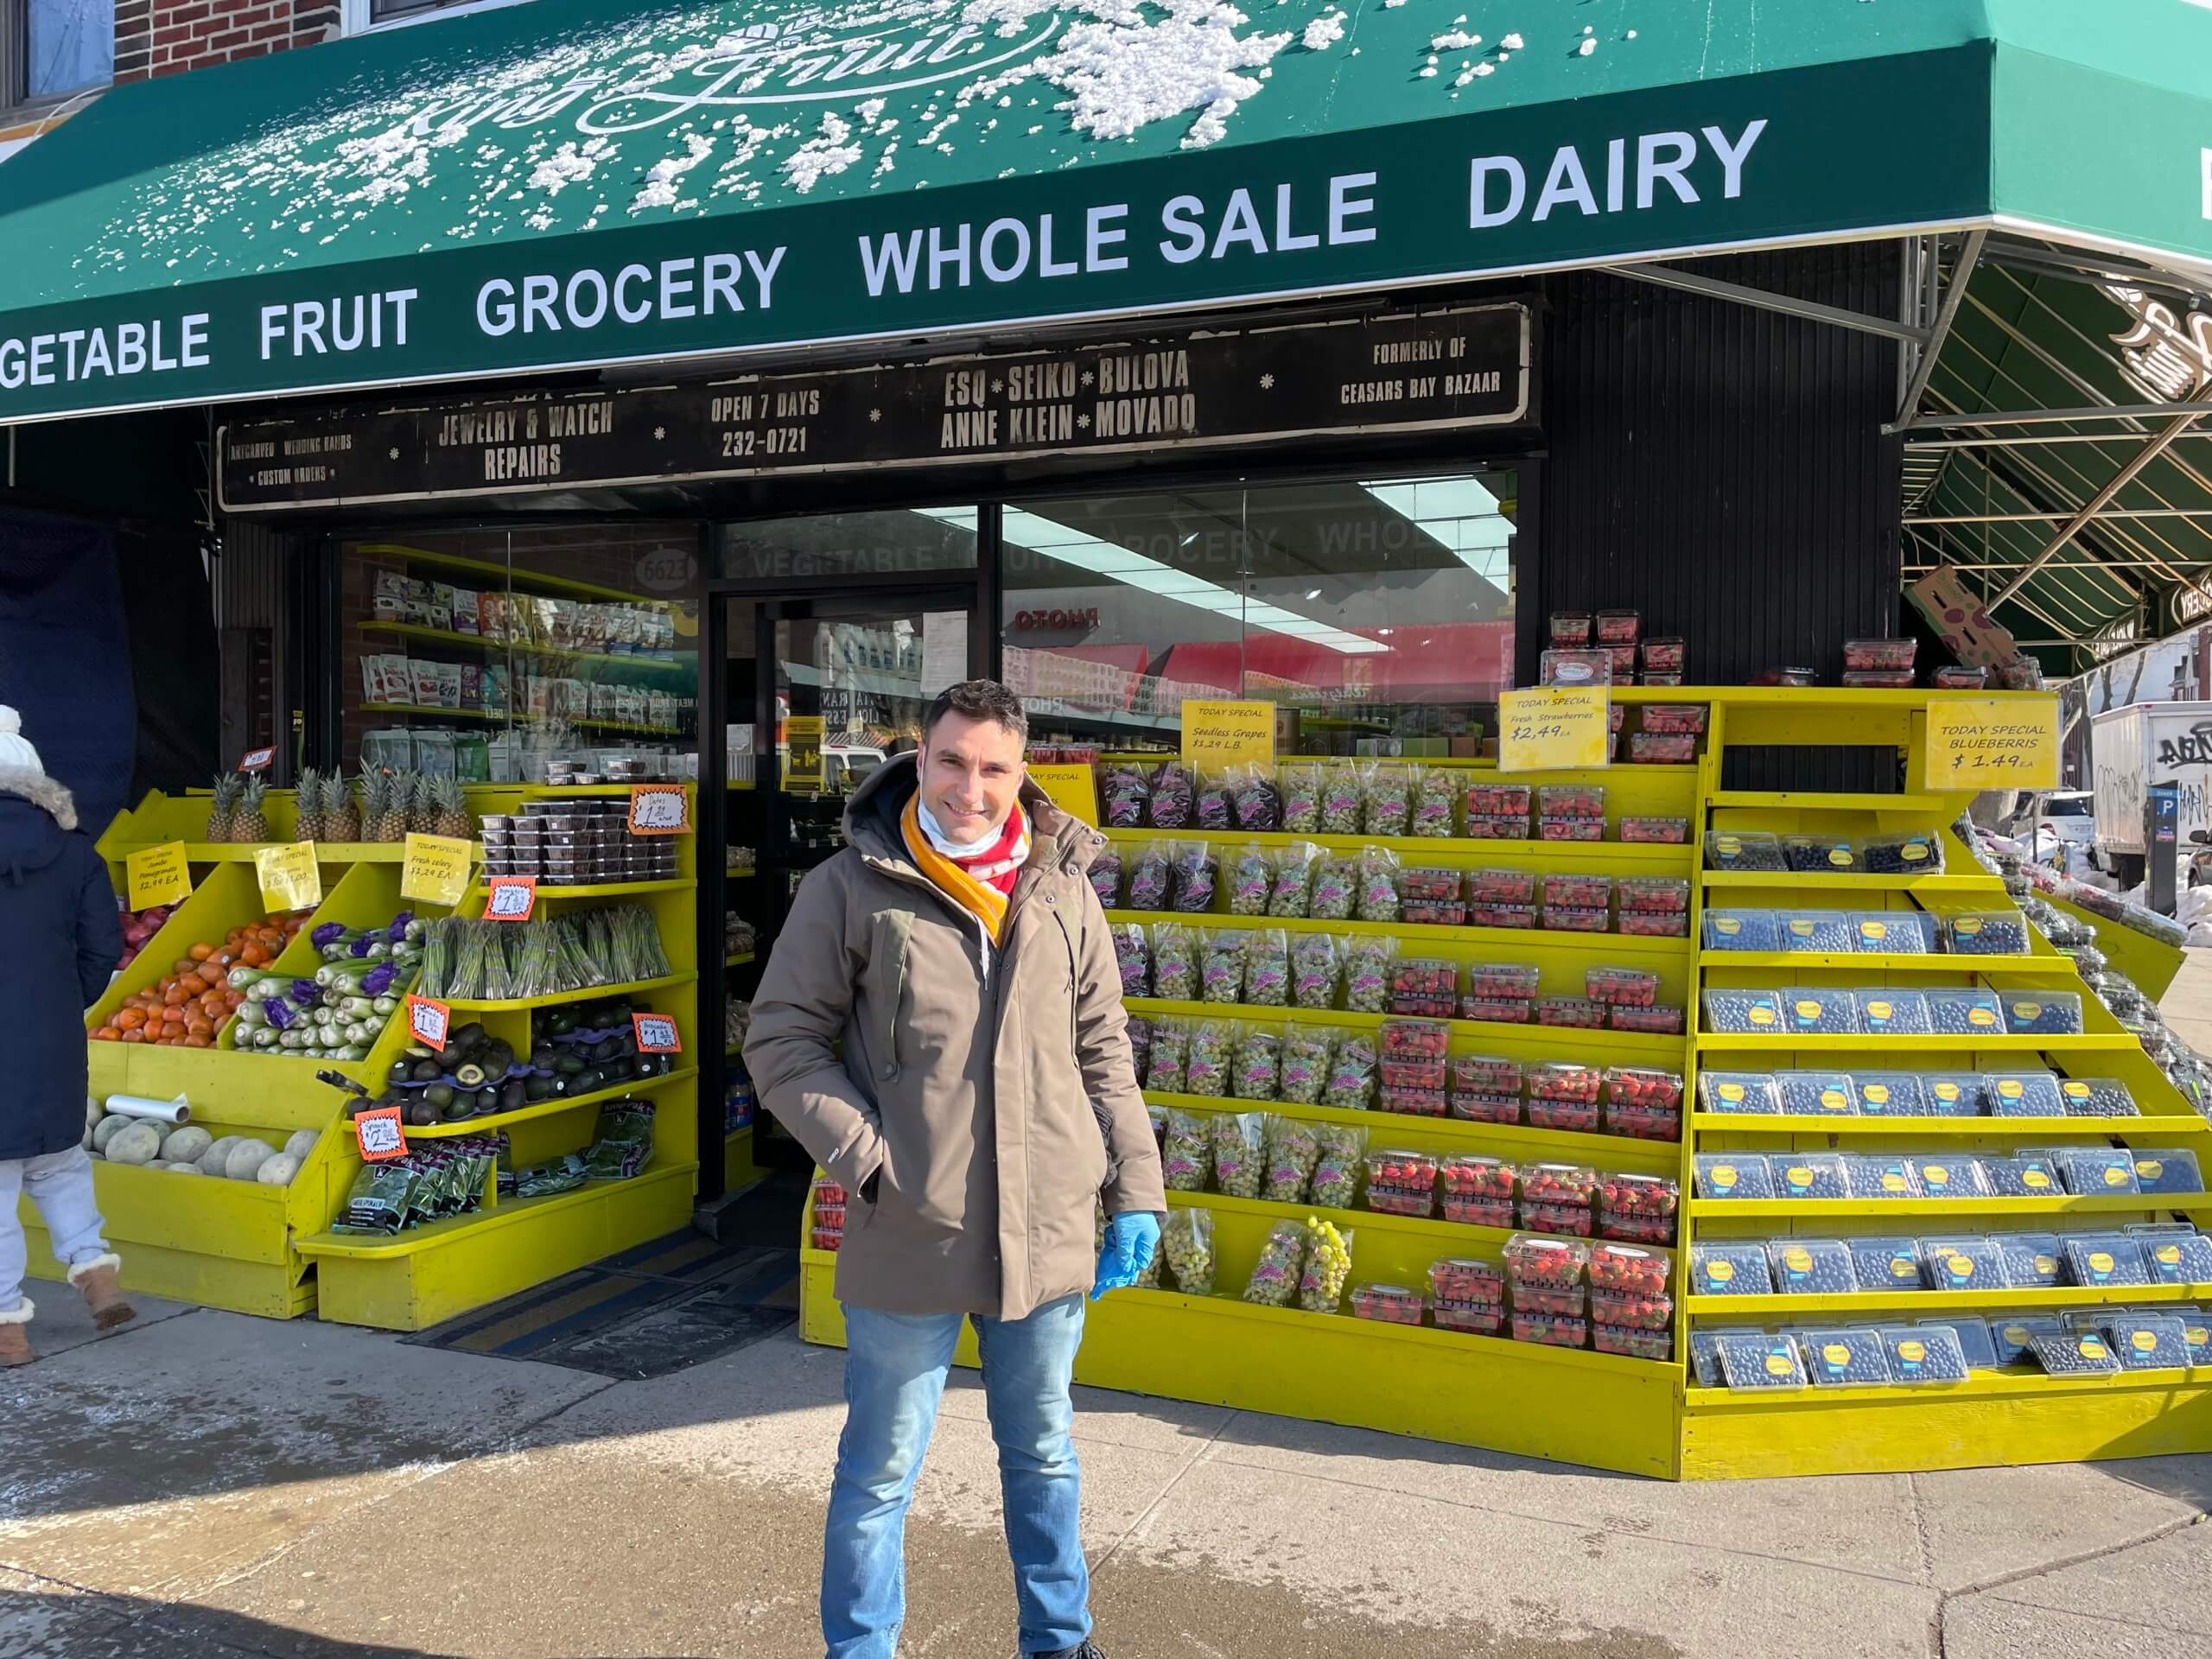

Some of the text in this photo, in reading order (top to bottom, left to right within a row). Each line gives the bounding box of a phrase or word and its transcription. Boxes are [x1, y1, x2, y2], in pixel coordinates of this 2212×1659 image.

[261, 289, 418, 360] FRUIT
[477, 246, 787, 337] GROCERY
[859, 204, 1128, 297] WHOLE
[1160, 172, 1377, 264] SALE
[1470, 119, 1769, 229] DAIRY
[1373, 337, 1466, 365] FORMERLY OF
[944, 350, 1190, 408] ESQ SEIKO BULOVA
[1341, 372, 1501, 404] CEASARS BAY BAZAAR
[710, 390, 820, 423] OPEN 7 DAYS
[439, 401, 613, 447] JEWELRY & WATCH
[942, 394, 1196, 449] ANNE KLEIN MOVADO
[722, 426, 807, 458] 232-0721
[485, 444, 561, 480] REPAIRS
[257, 468, 290, 486] CUSTOM
[1198, 708, 1263, 717] TODAY SPECIAL
[1516, 696, 1592, 709] TODAY SPECIAL
[1510, 711, 1594, 723] Fresh Strawberries
[1192, 727, 1267, 741] Seedless Grapes
[1941, 724, 2047, 735] TODAY SPECIAL
[1949, 738, 2038, 749] BLUEBERRIS
[2163, 800, 2174, 814] P
[411, 855, 430, 865] Fresh
